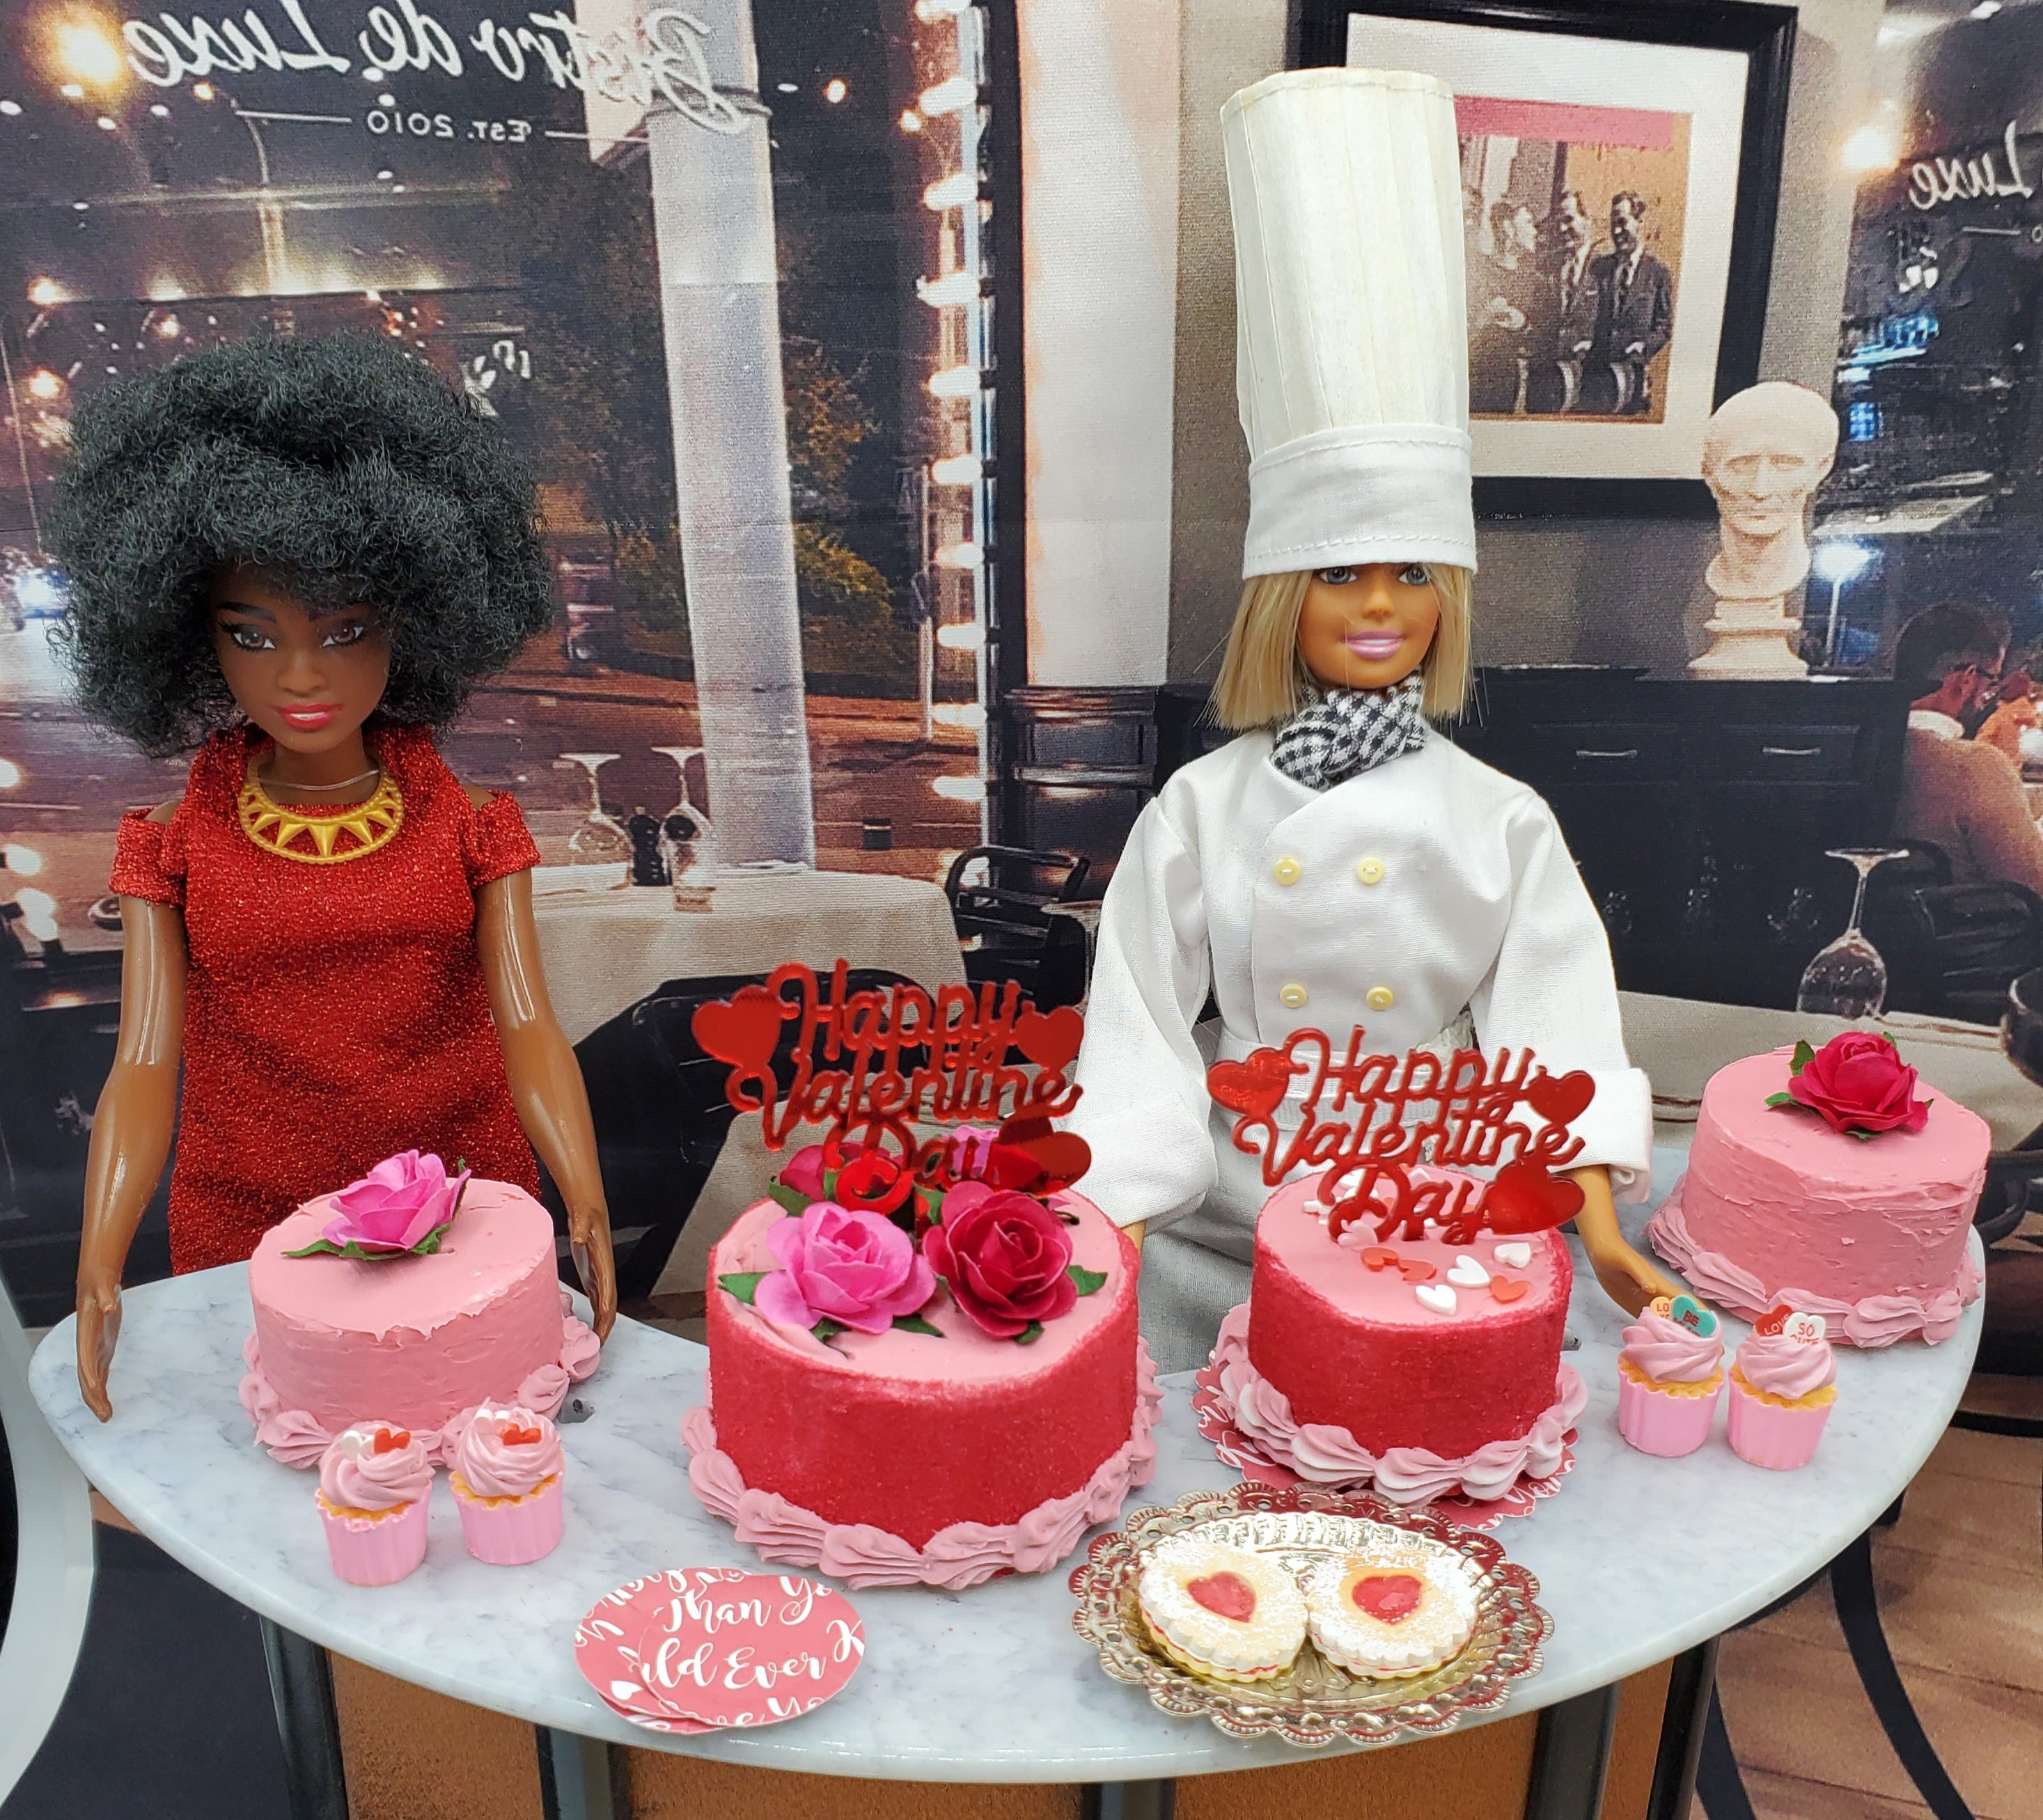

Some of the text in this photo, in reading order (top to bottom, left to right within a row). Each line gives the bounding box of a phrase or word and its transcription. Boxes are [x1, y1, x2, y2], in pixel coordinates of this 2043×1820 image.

[766, 957, 1020, 1078] Happy
[726, 1046, 1083, 1150] Valentine
[1283, 1024, 1537, 1124] Happy
[822, 1114, 1000, 1216] Day
[1231, 1101, 1586, 1186] Valentine
[1317, 1161, 1492, 1245] Day
[1683, 1310, 1700, 1327] BE
[1798, 1322, 1815, 1337] SO
[723, 1647, 827, 1690] Ever
